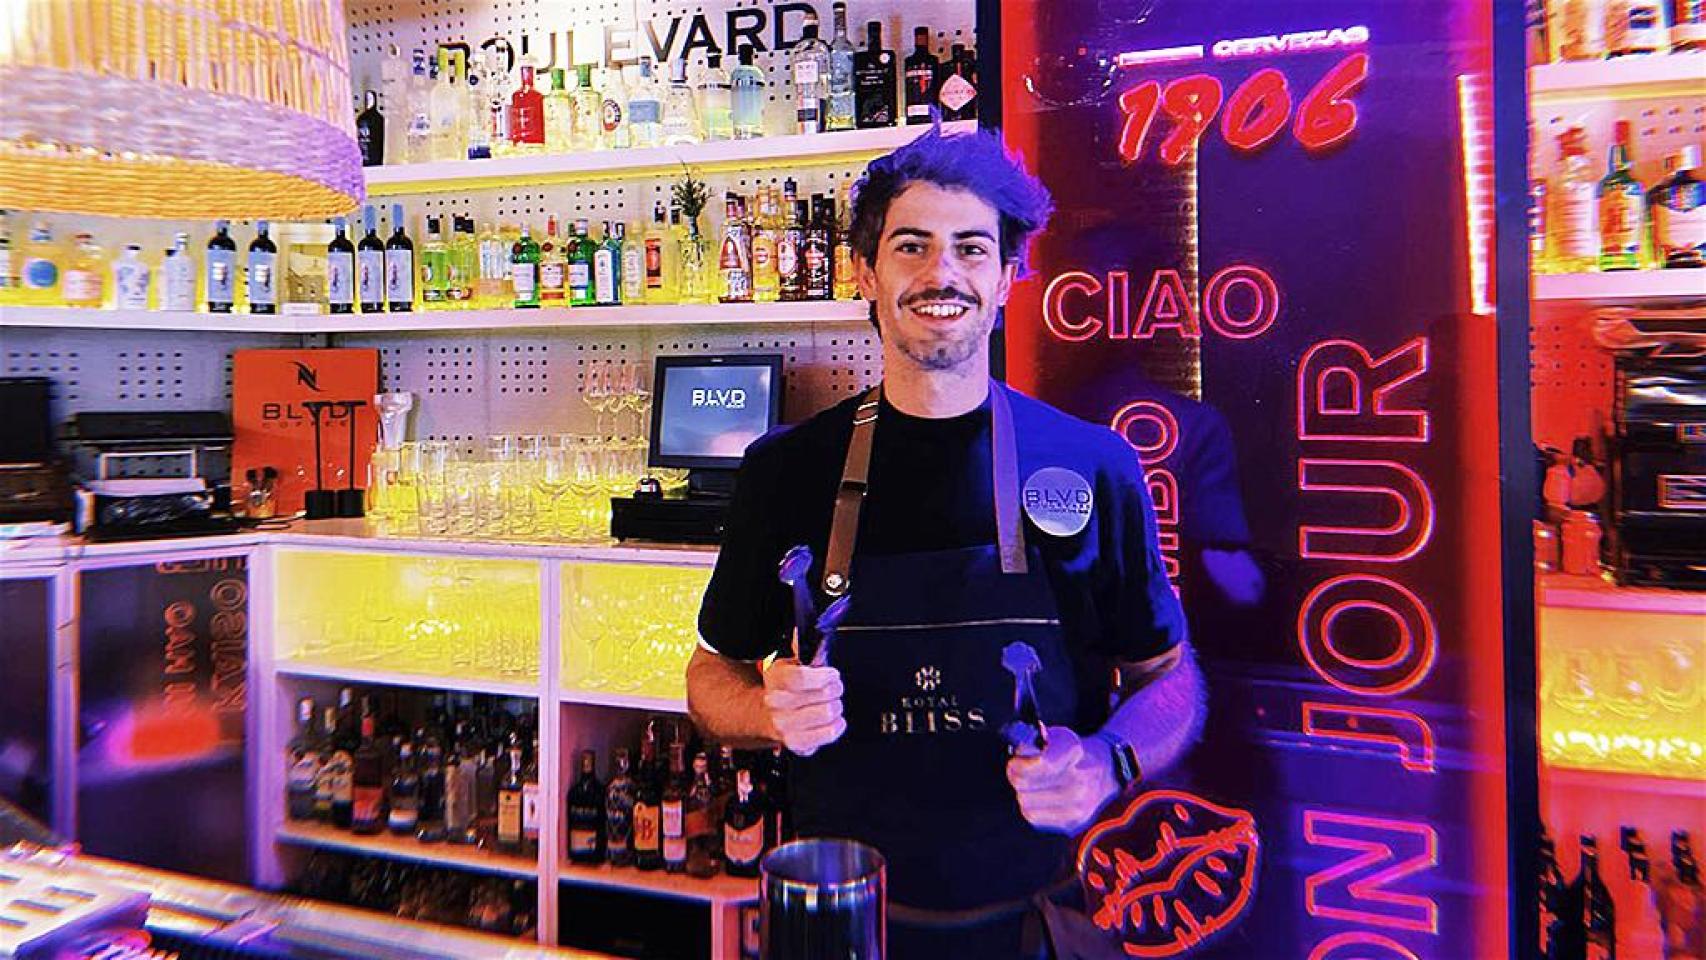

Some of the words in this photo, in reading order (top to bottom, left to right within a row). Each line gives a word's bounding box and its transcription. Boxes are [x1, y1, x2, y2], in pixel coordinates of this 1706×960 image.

[1212, 25, 1370, 57] CERVEZAS
[1119, 53, 1369, 165] 1906
[1042, 264, 1279, 342] CIAO
[692, 388, 746, 406] BLVD
[1025, 489, 1090, 504] BLVD
[1297, 336, 1438, 773] JOUR
[880, 708, 986, 734] BLISS
